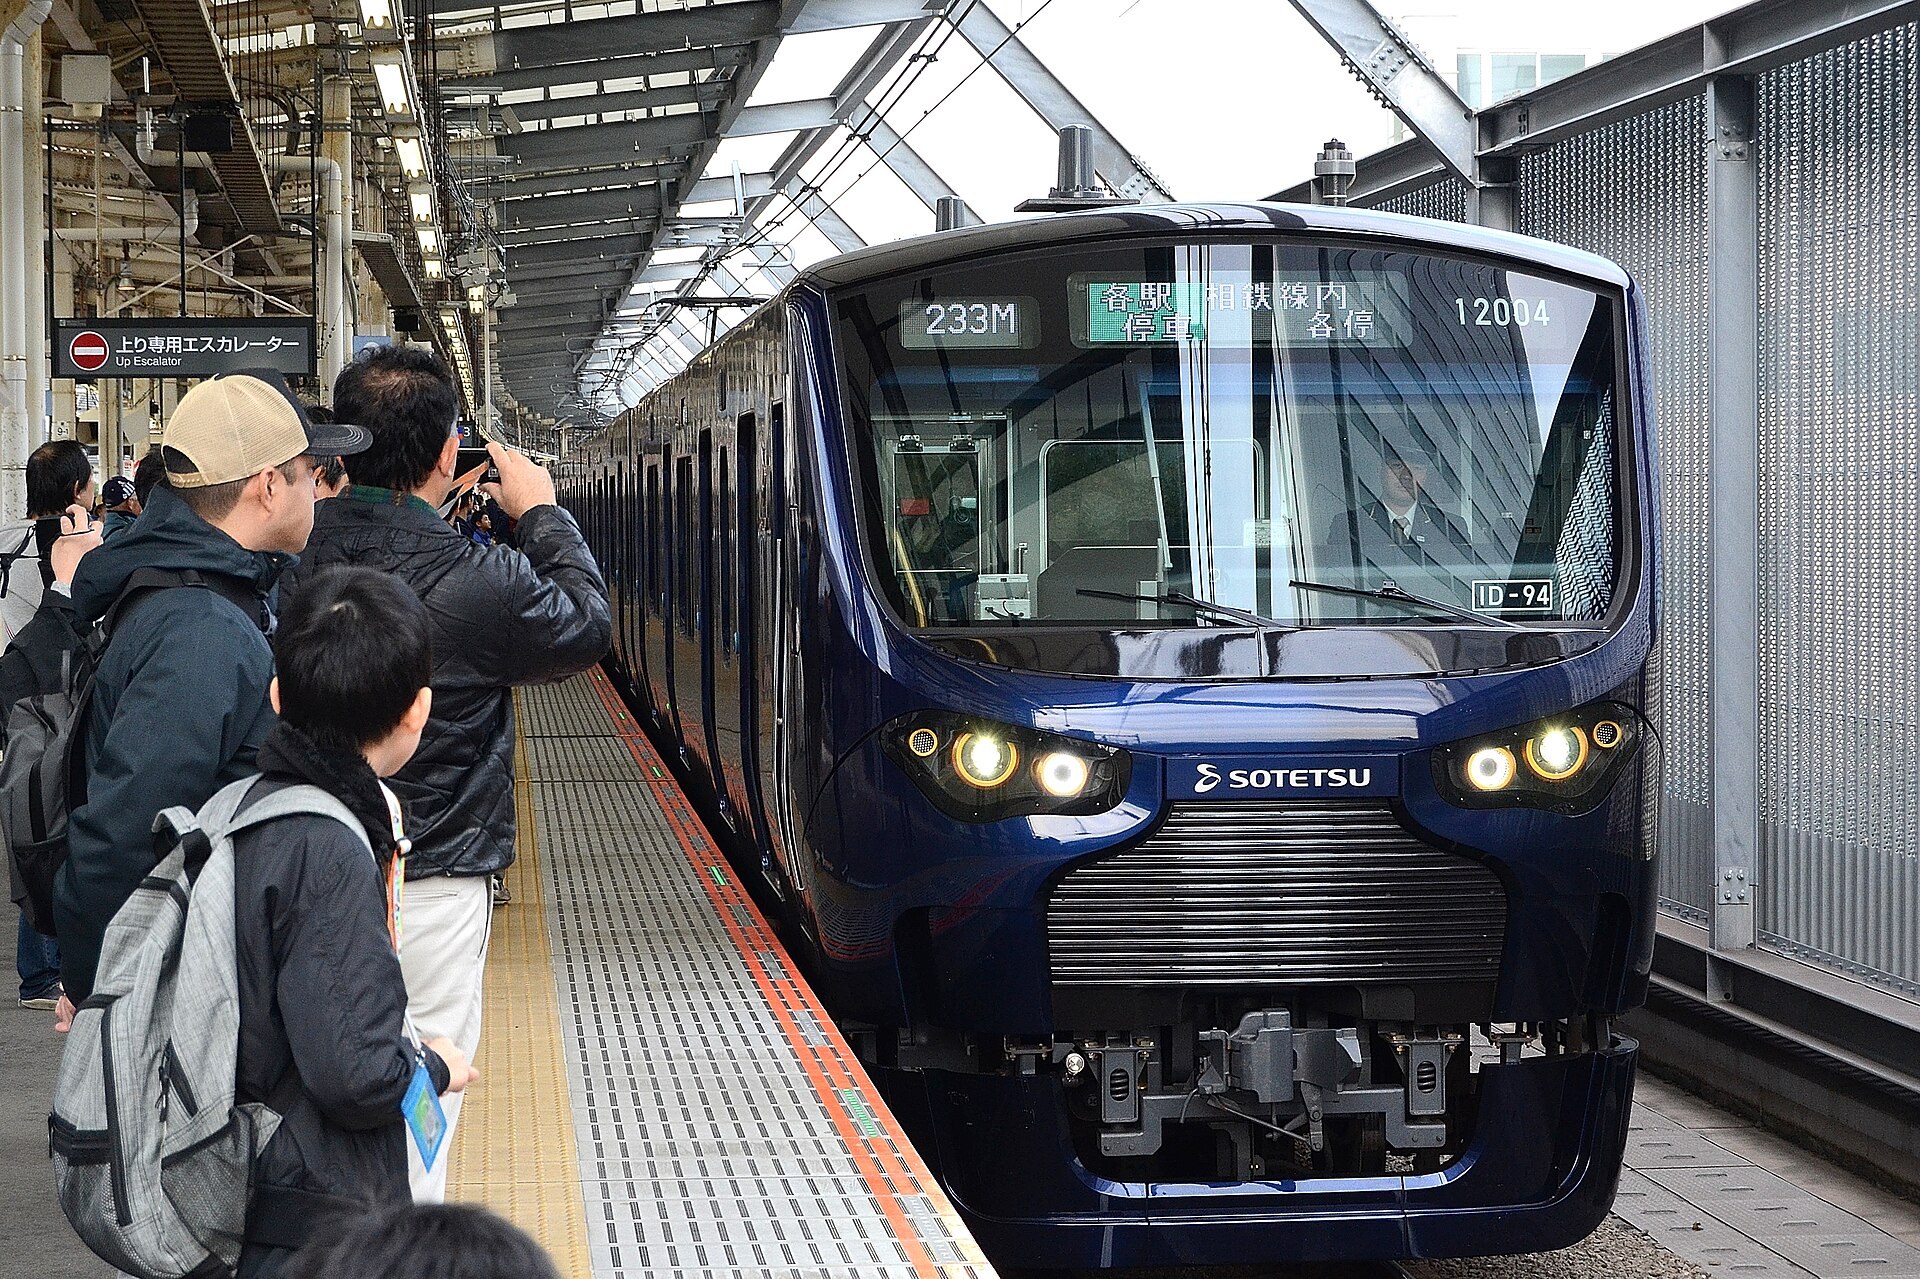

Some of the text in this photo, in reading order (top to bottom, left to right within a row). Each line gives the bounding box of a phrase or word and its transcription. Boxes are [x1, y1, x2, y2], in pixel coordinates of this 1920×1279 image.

[1101, 282, 1174, 312] 各駅
[1206, 281, 1347, 311] 相鉄線内
[925, 303, 1015, 335] 233M
[1306, 310, 1374, 339] 各停
[1455, 297, 1550, 327] 12004
[1121, 312, 1194, 342] 停車
[115, 336, 300, 354] 上り専用エスカレーター
[116, 356, 182, 368] Up Escalator
[1479, 584, 1550, 606] ID-94
[1229, 768, 1371, 789] SOTETSU
